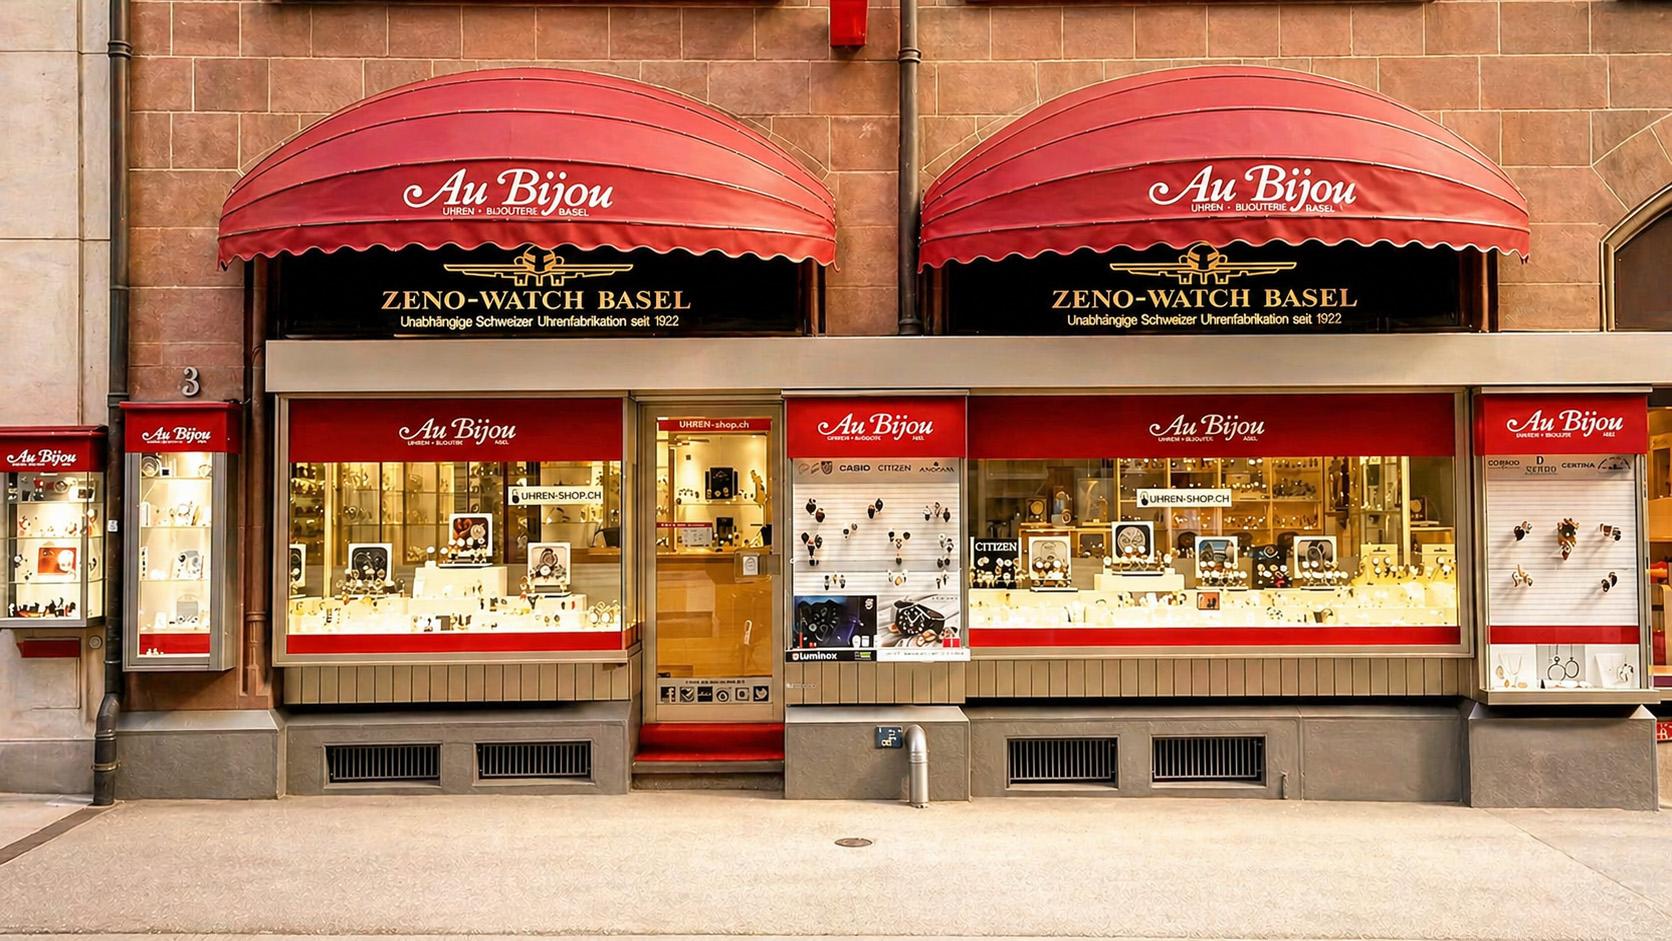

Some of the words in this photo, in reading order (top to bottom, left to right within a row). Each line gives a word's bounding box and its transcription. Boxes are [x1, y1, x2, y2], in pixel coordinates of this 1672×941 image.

[403, 168, 488, 208] Au
[497, 168, 613, 216] Bijou
[1149, 165, 1236, 205] Au
[1245, 164, 1357, 212] Bijou
[442, 207, 475, 216] UHREN
[559, 208, 589, 217] BASEL
[1191, 203, 1223, 212] UHREN
[1235, 203, 1287, 212] BIJOUTERIE
[381, 290, 585, 310] ZENO-WATCH
[598, 290, 691, 310] BASEL
[1052, 289, 1251, 309] ZENO-WATCH
[1264, 288, 1358, 308] BASEL
[400, 315, 473, 330] Unabhängige
[476, 315, 533, 328] Schweizer
[537, 315, 626, 327] Uhrenfabrikation
[631, 315, 650, 327] seit
[655, 315, 679, 327] 1922
[1067, 313, 1138, 328] Unabhängige
[1141, 313, 1198, 326] Schweizer
[1200, 312, 1289, 326] Uhrenfabrikation
[1293, 312, 1312, 325] seit
[1317, 312, 1342, 325] 1922
[181, 366, 200, 397] 3
[399, 417, 447, 440] Au
[451, 417, 517, 445] Bijou
[818, 413, 866, 435] Au
[869, 413, 934, 441] Bijou
[1149, 414, 1197, 436] Au
[1201, 414, 1265, 441] Bijou
[1506, 410, 1554, 432] Au
[1559, 409, 1623, 437] Bijou
[142, 426, 170, 441] Au
[173, 426, 211, 444] Bijou
[6, 449, 37, 464] Au
[38, 449, 77, 467] Bijou
[839, 464, 871, 472] CASIO
[975, 542, 1018, 552] CITIZEN
